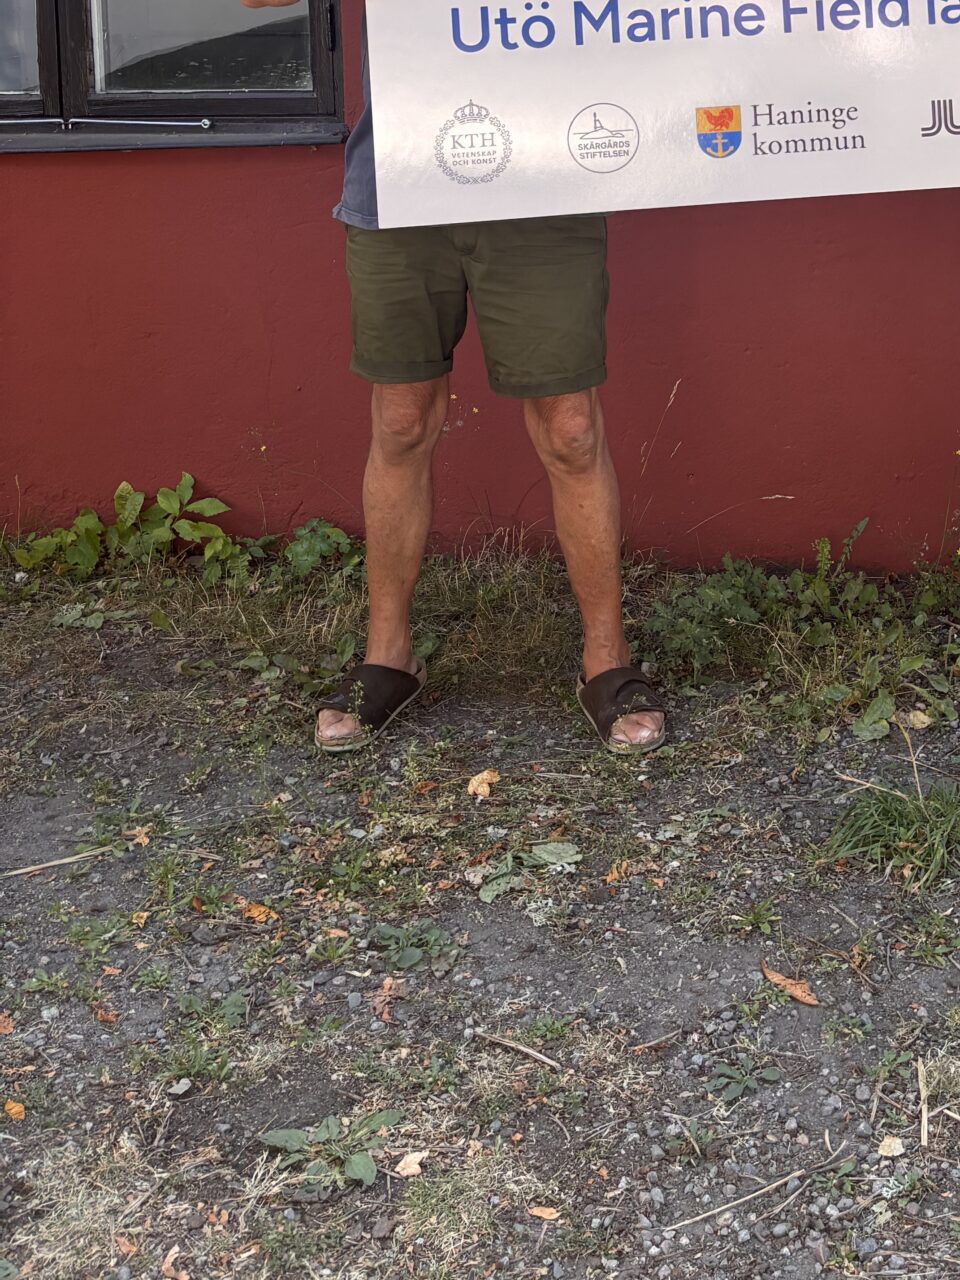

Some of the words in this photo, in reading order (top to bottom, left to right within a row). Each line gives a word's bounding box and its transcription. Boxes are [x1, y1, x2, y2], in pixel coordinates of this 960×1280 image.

[451, 1, 556, 53] Utö
[751, 101, 859, 129] Haninge
[451, 132, 497, 150] KTH
[577, 140, 630, 151] SKÄRGÅRDS
[752, 132, 866, 156] kommun
[451, 150, 497, 159] VETENSKAP
[472, 157, 497, 165] KONST
[579, 149, 630, 160] STIFTELSEN
